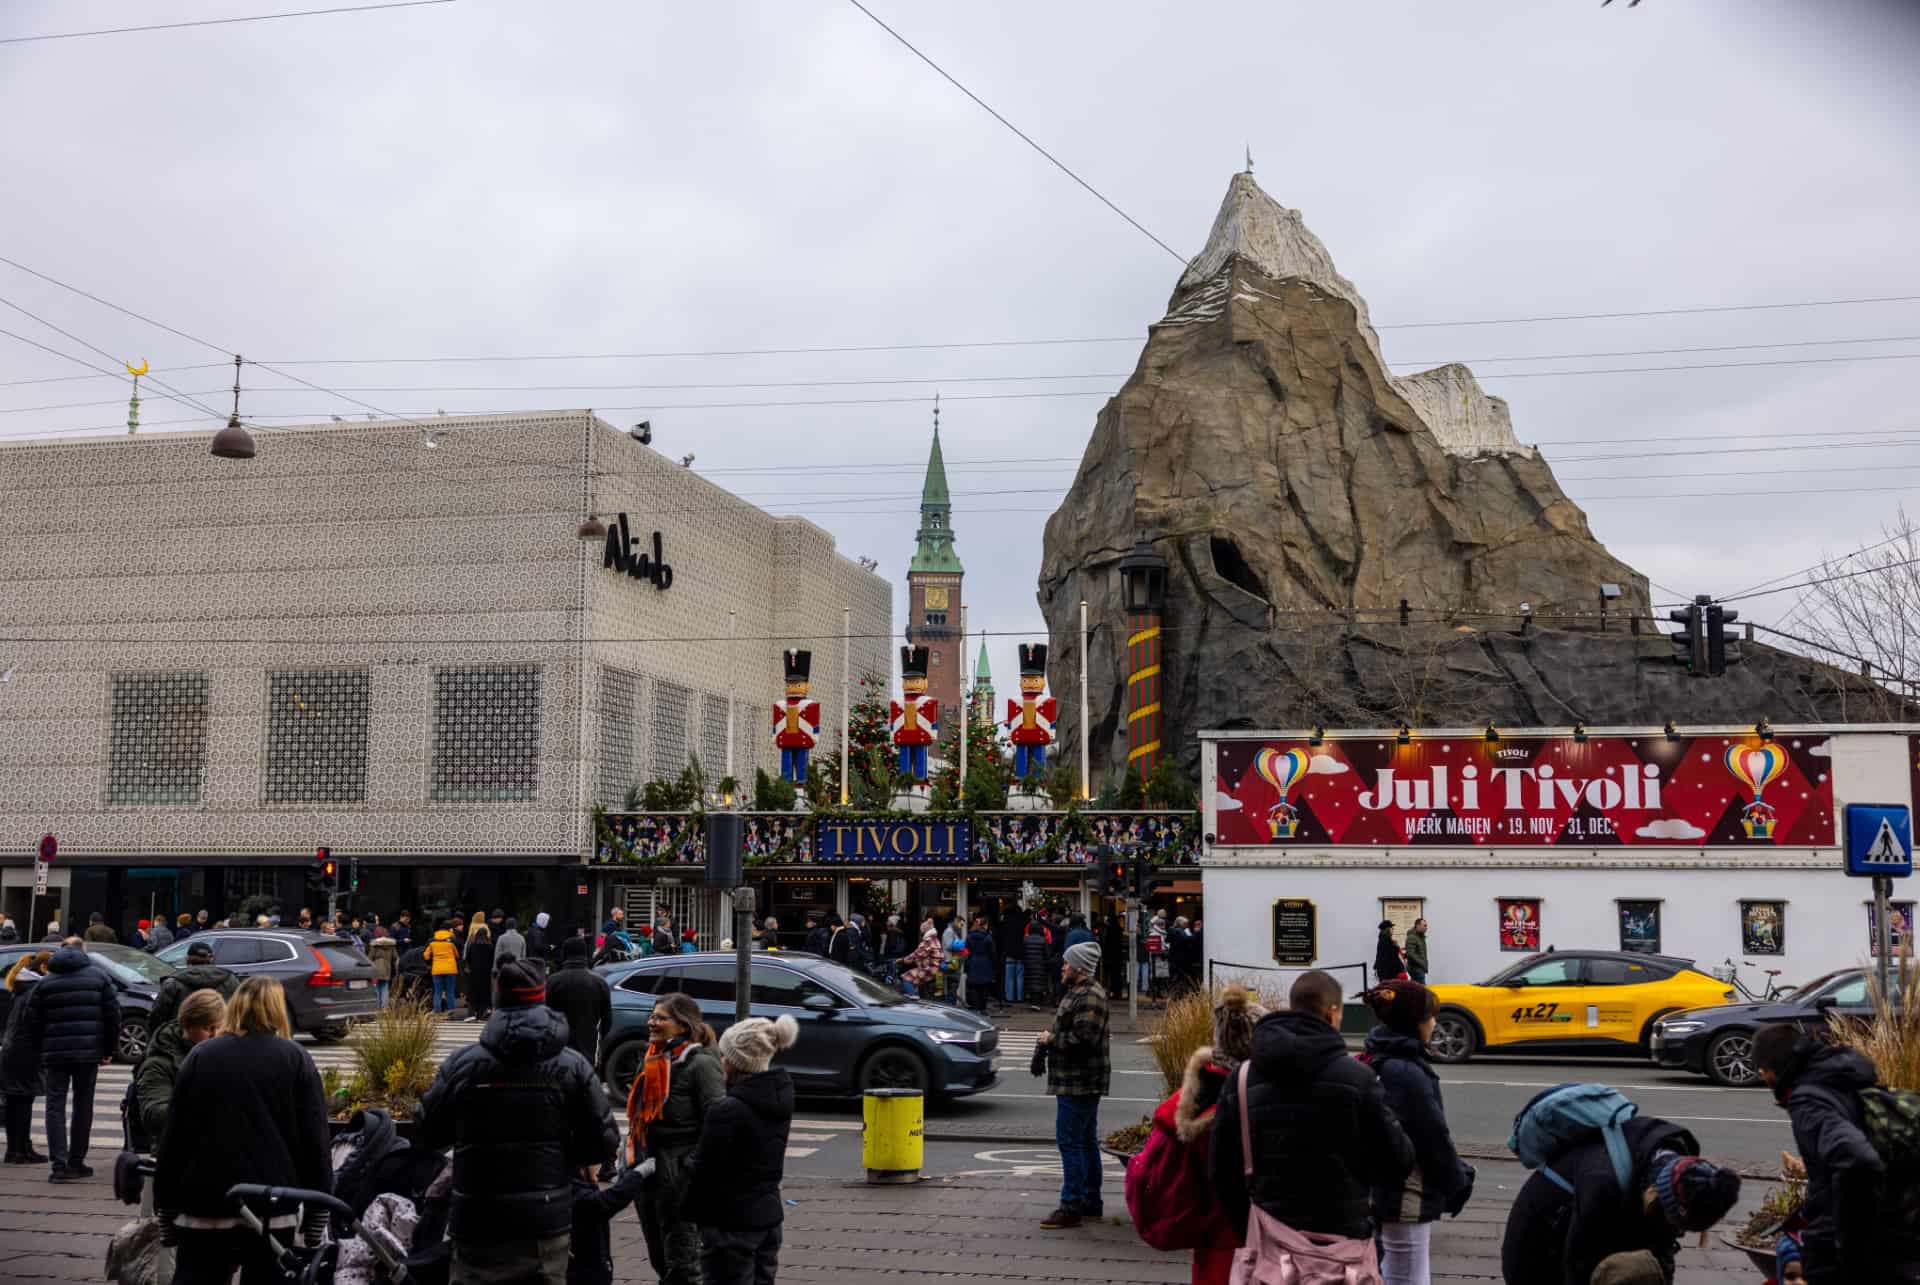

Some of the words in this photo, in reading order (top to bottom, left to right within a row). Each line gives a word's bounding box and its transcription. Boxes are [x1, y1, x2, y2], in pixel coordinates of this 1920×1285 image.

[1496, 748, 1528, 758] TIVOLI
[1358, 765, 1450, 810] Jul
[1460, 764, 1480, 810] i
[1490, 763, 1663, 810] Tivoli
[1405, 817, 1442, 835] MÆRK
[1446, 817, 1491, 835] MAGIEN
[1508, 817, 1527, 835] 19.
[1530, 817, 1557, 835] NOV.
[1568, 817, 1585, 835] 31.
[1589, 817, 1616, 835] DEC.
[827, 825, 957, 855] TIVOLI
